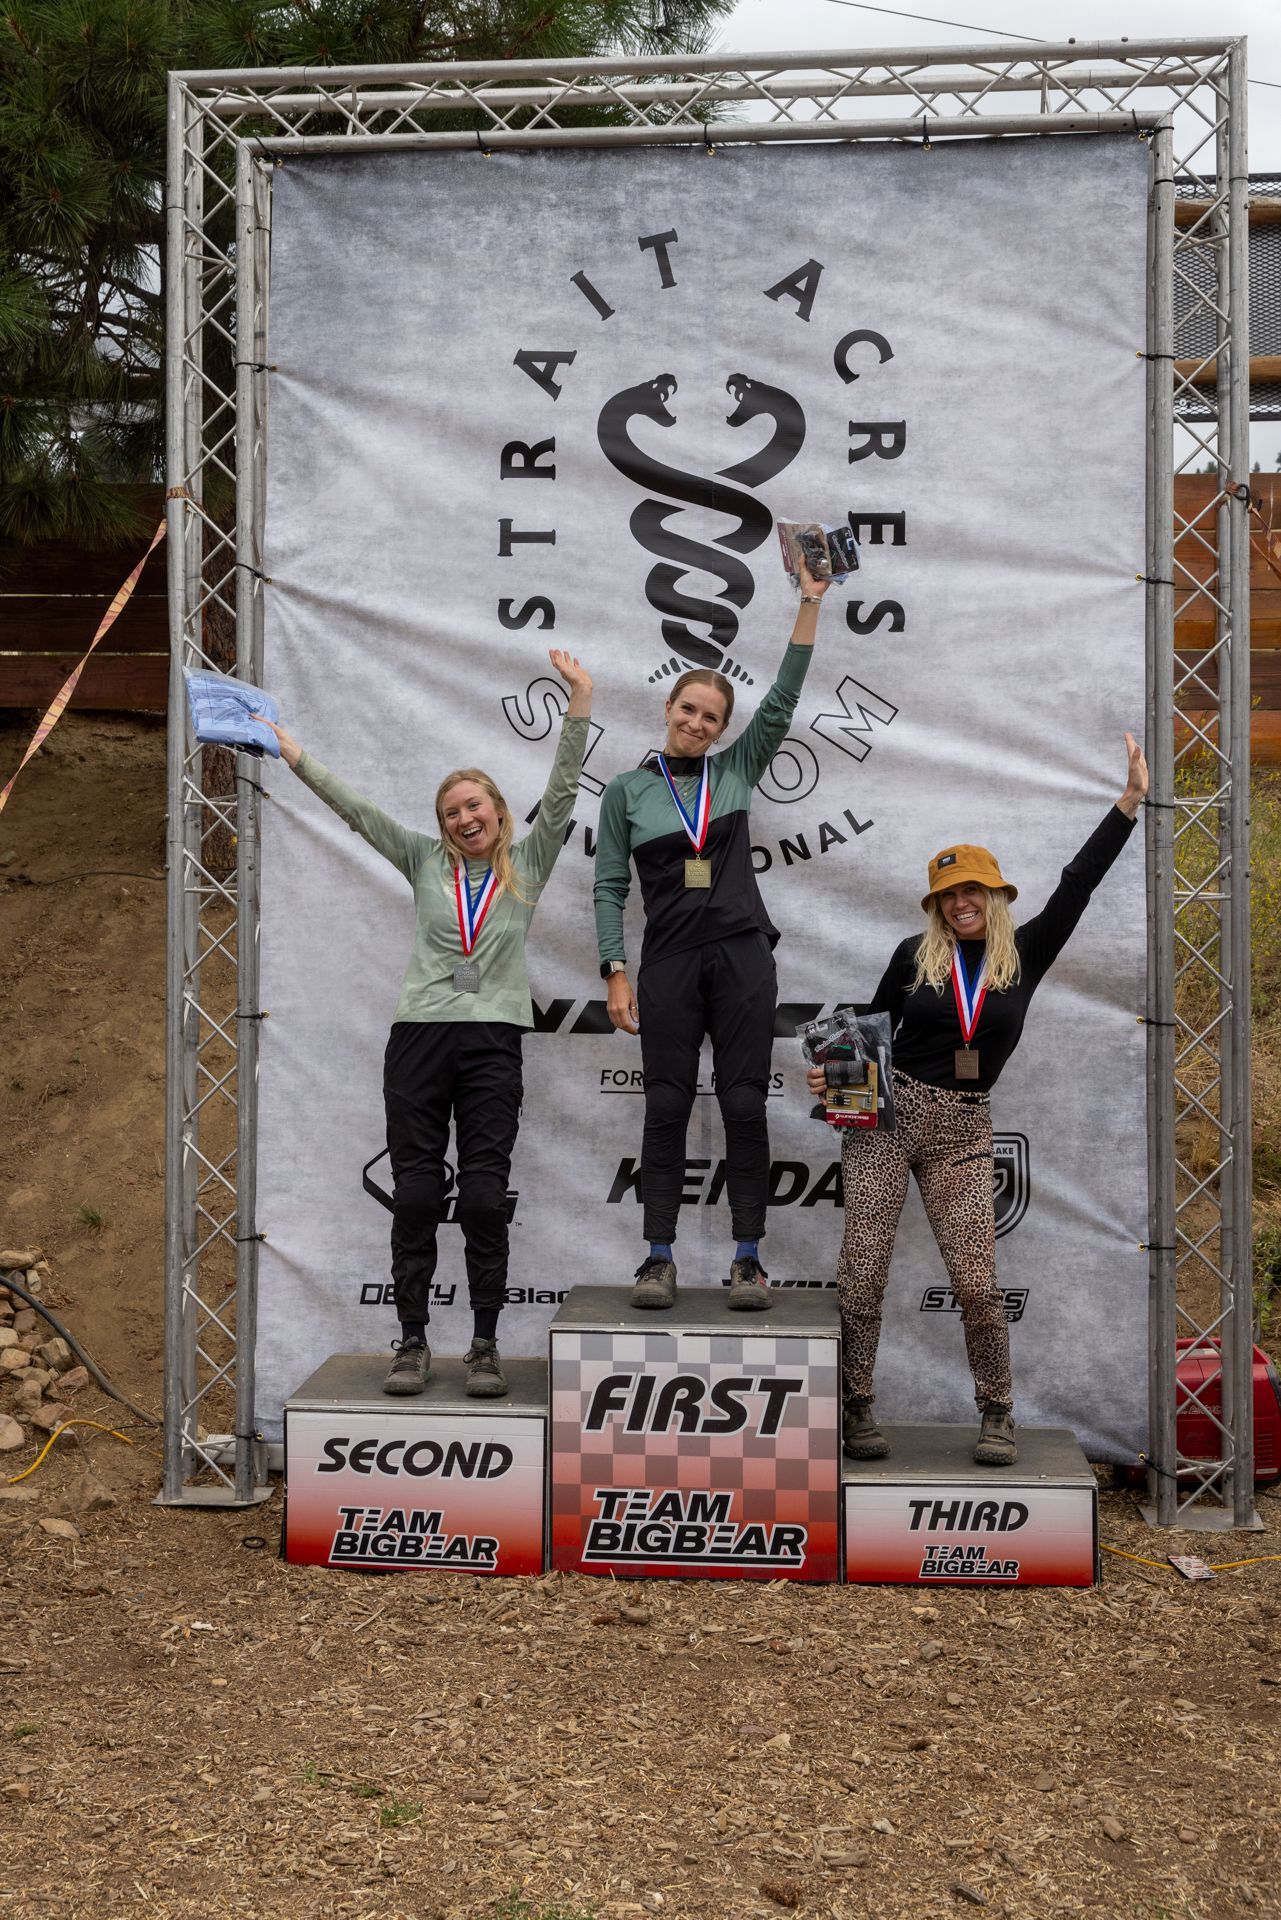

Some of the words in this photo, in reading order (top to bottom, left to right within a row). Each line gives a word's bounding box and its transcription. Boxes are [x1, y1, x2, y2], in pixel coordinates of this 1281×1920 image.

[497, 227, 678, 630] STRAIT
[763, 258, 907, 635] ACRES
[600, 1069, 644, 1086] FOR
[993, 1146, 1014, 1155] AKE
[585, 1373, 803, 1436] FIRST
[317, 1437, 513, 1479] SECOND
[339, 1507, 442, 1534] TEAM
[595, 1491, 731, 1525] TEAM
[908, 1500, 1029, 1532] THIRD
[332, 1531, 499, 1561] BIGBEAR
[586, 1523, 807, 1556] BIGBEAR
[924, 1546, 986, 1560] TEAM
[921, 1559, 1019, 1574] BIGBEAR
